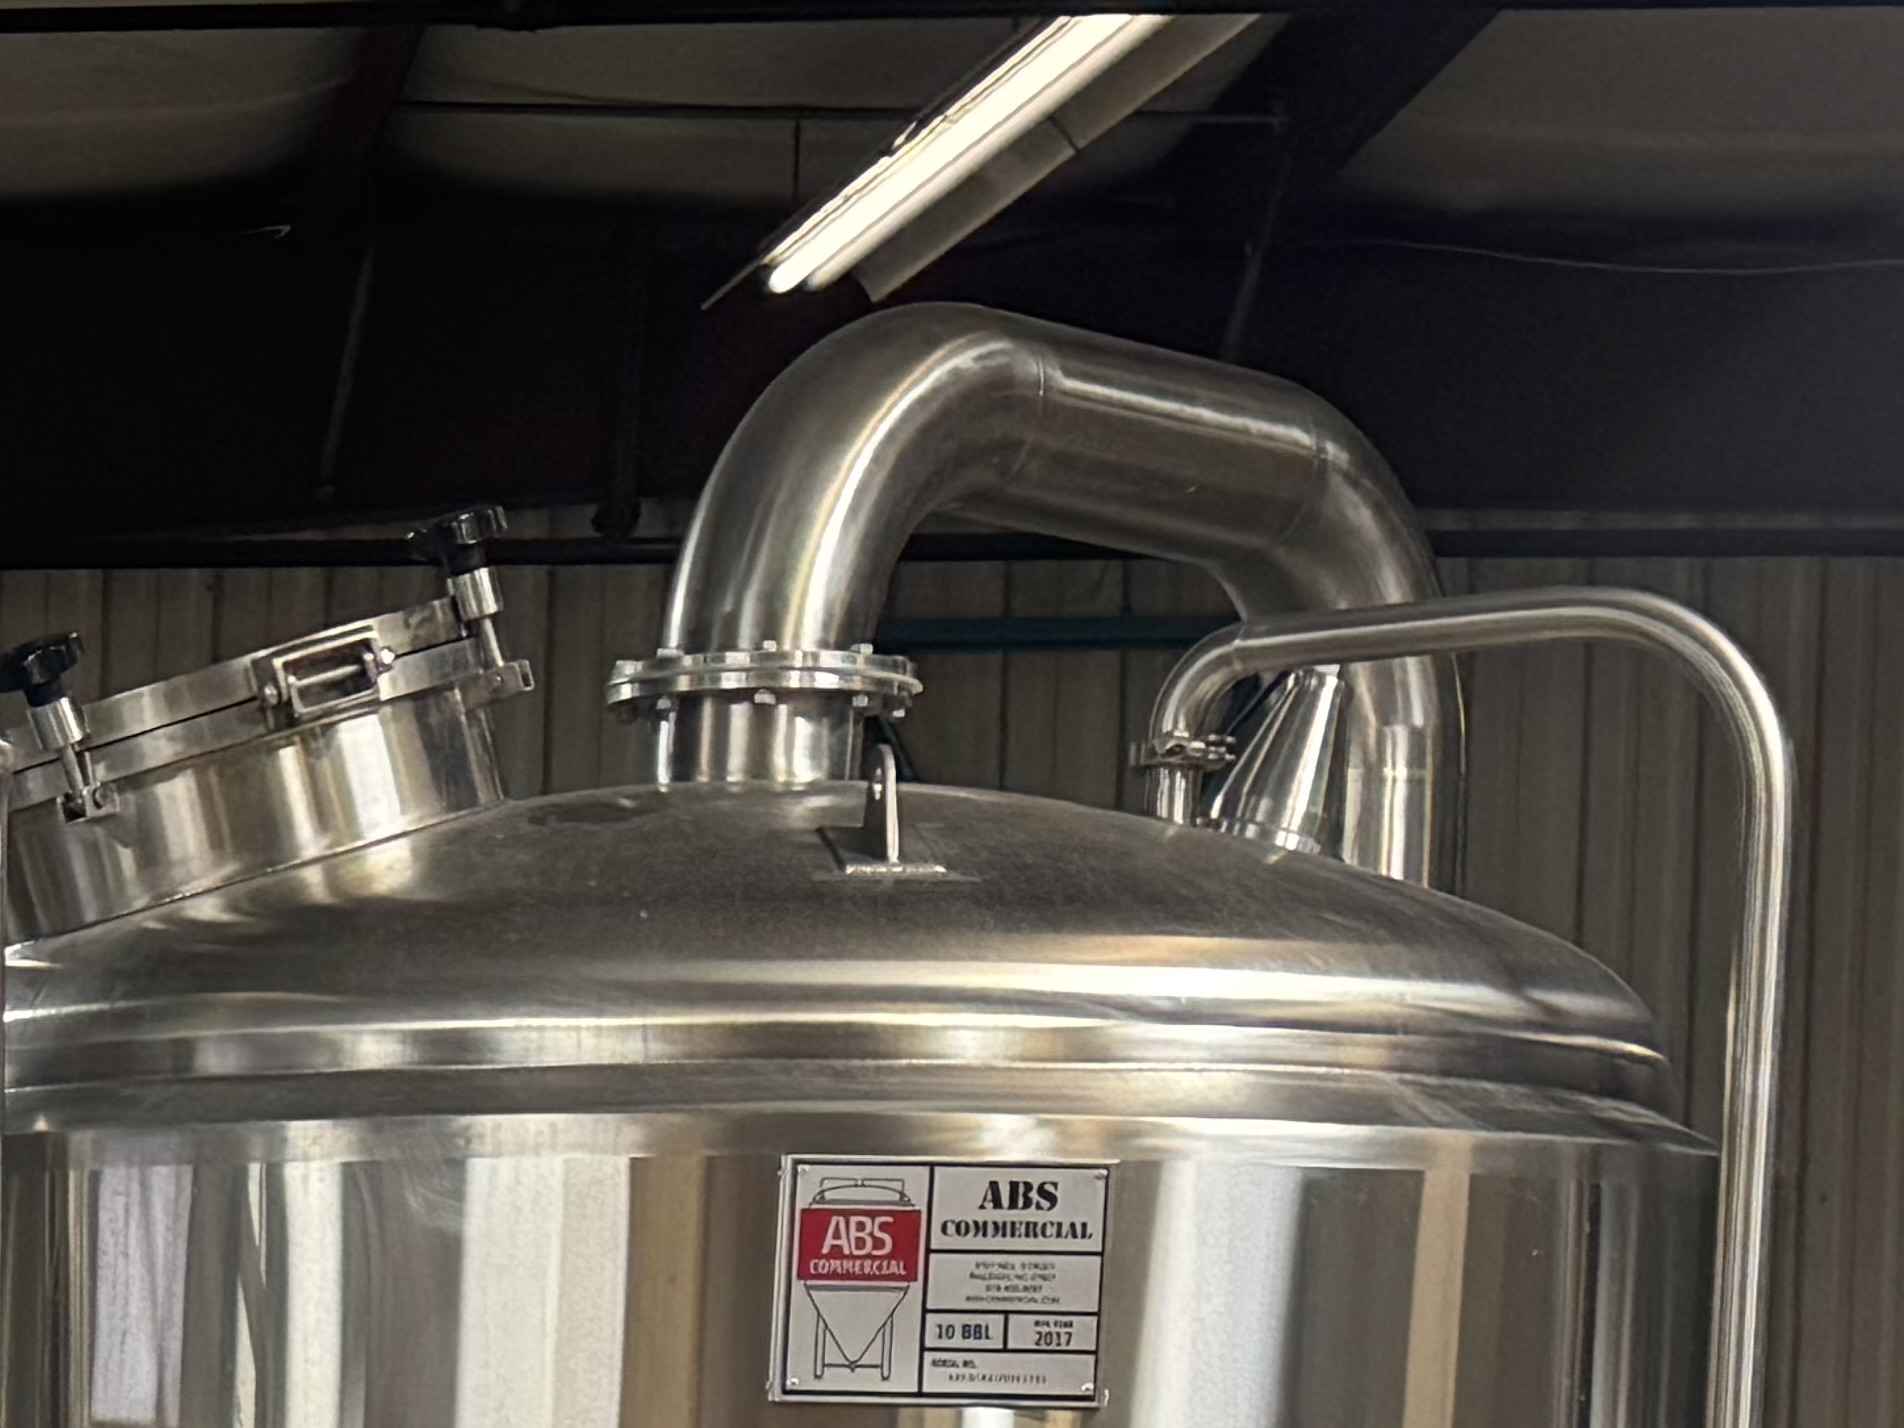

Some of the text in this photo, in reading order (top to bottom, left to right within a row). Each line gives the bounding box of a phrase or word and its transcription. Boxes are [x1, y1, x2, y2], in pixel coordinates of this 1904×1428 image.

[978, 1180, 1059, 1212] ABS
[821, 1215, 895, 1256] ABS
[940, 1219, 1094, 1240] COMMERCIAL
[808, 1258, 907, 1277] COMMERCIAL
[936, 1323, 993, 1341] 10 BBL
[1033, 1330, 1073, 1347] 2017
